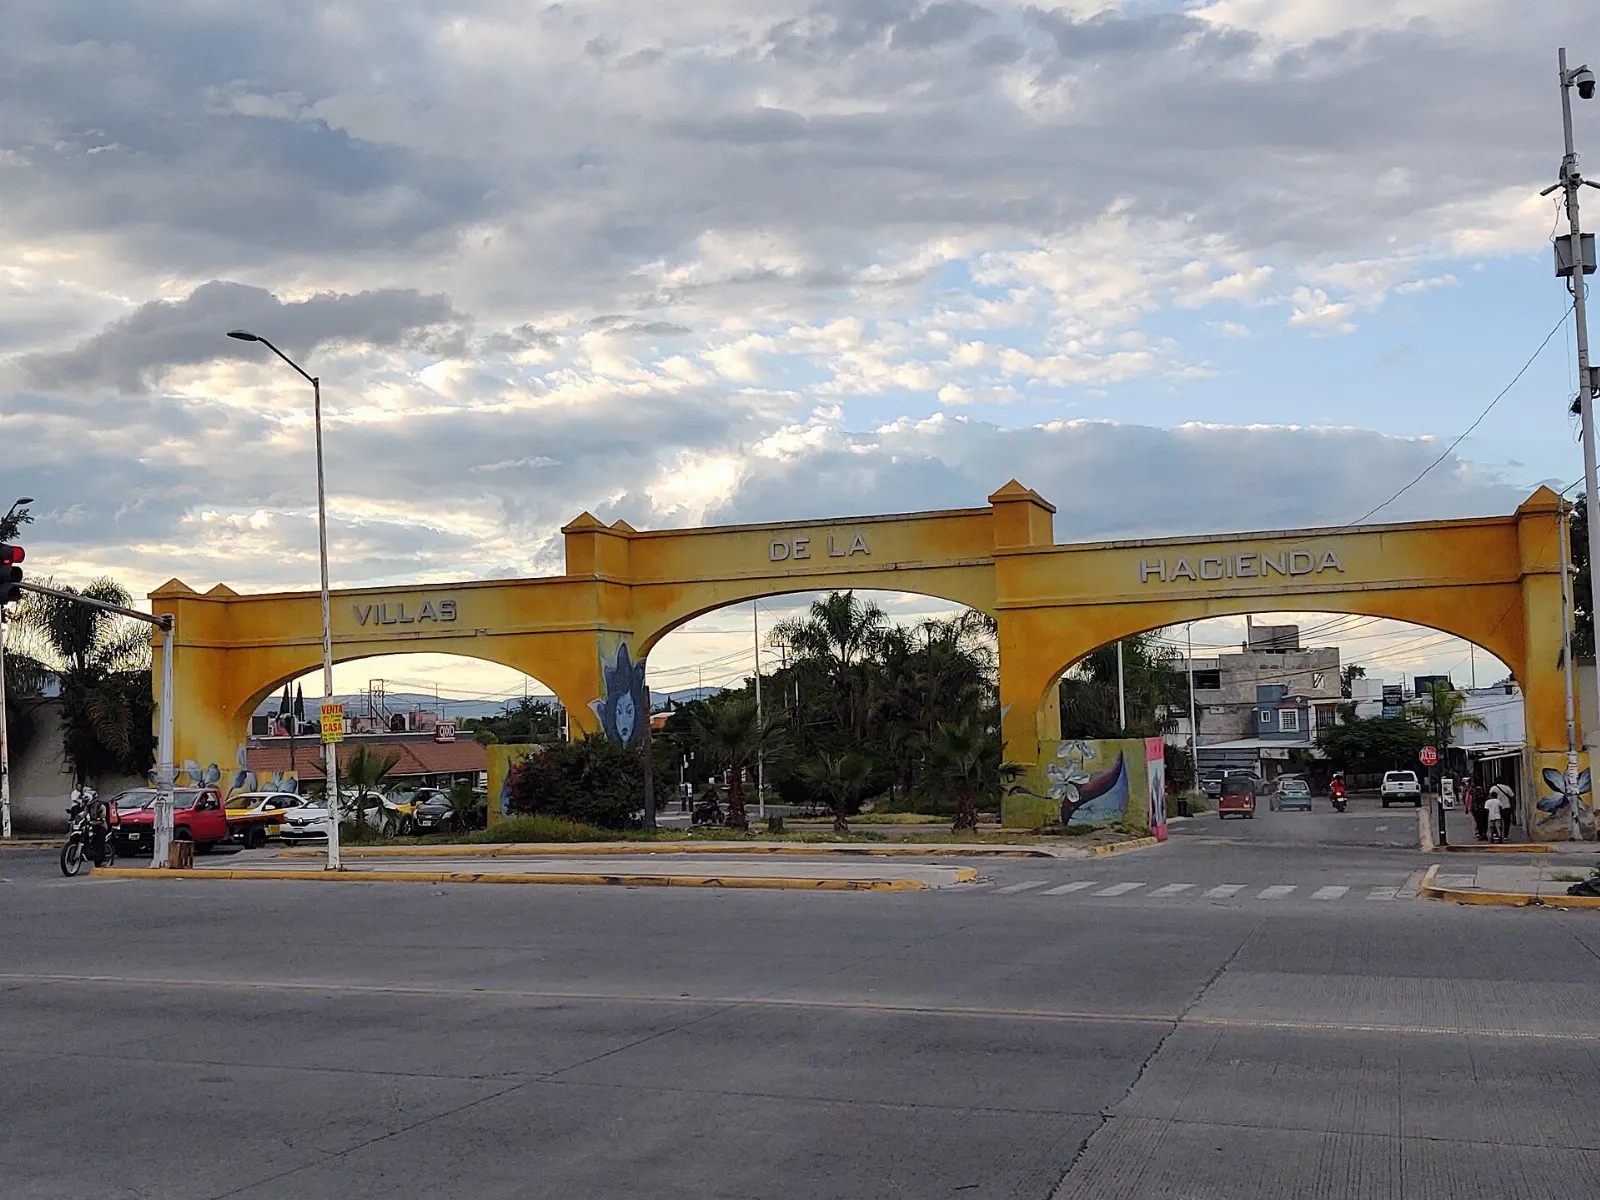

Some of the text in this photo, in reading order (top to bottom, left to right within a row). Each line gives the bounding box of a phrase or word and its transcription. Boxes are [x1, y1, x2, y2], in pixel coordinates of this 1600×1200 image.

[769, 532, 871, 561] DE LA
[1139, 549, 1345, 583] HACIENDA
[352, 599, 457, 626] VILLAS
[321, 704, 343, 714] VENTA
[322, 722, 343, 732] CASA
